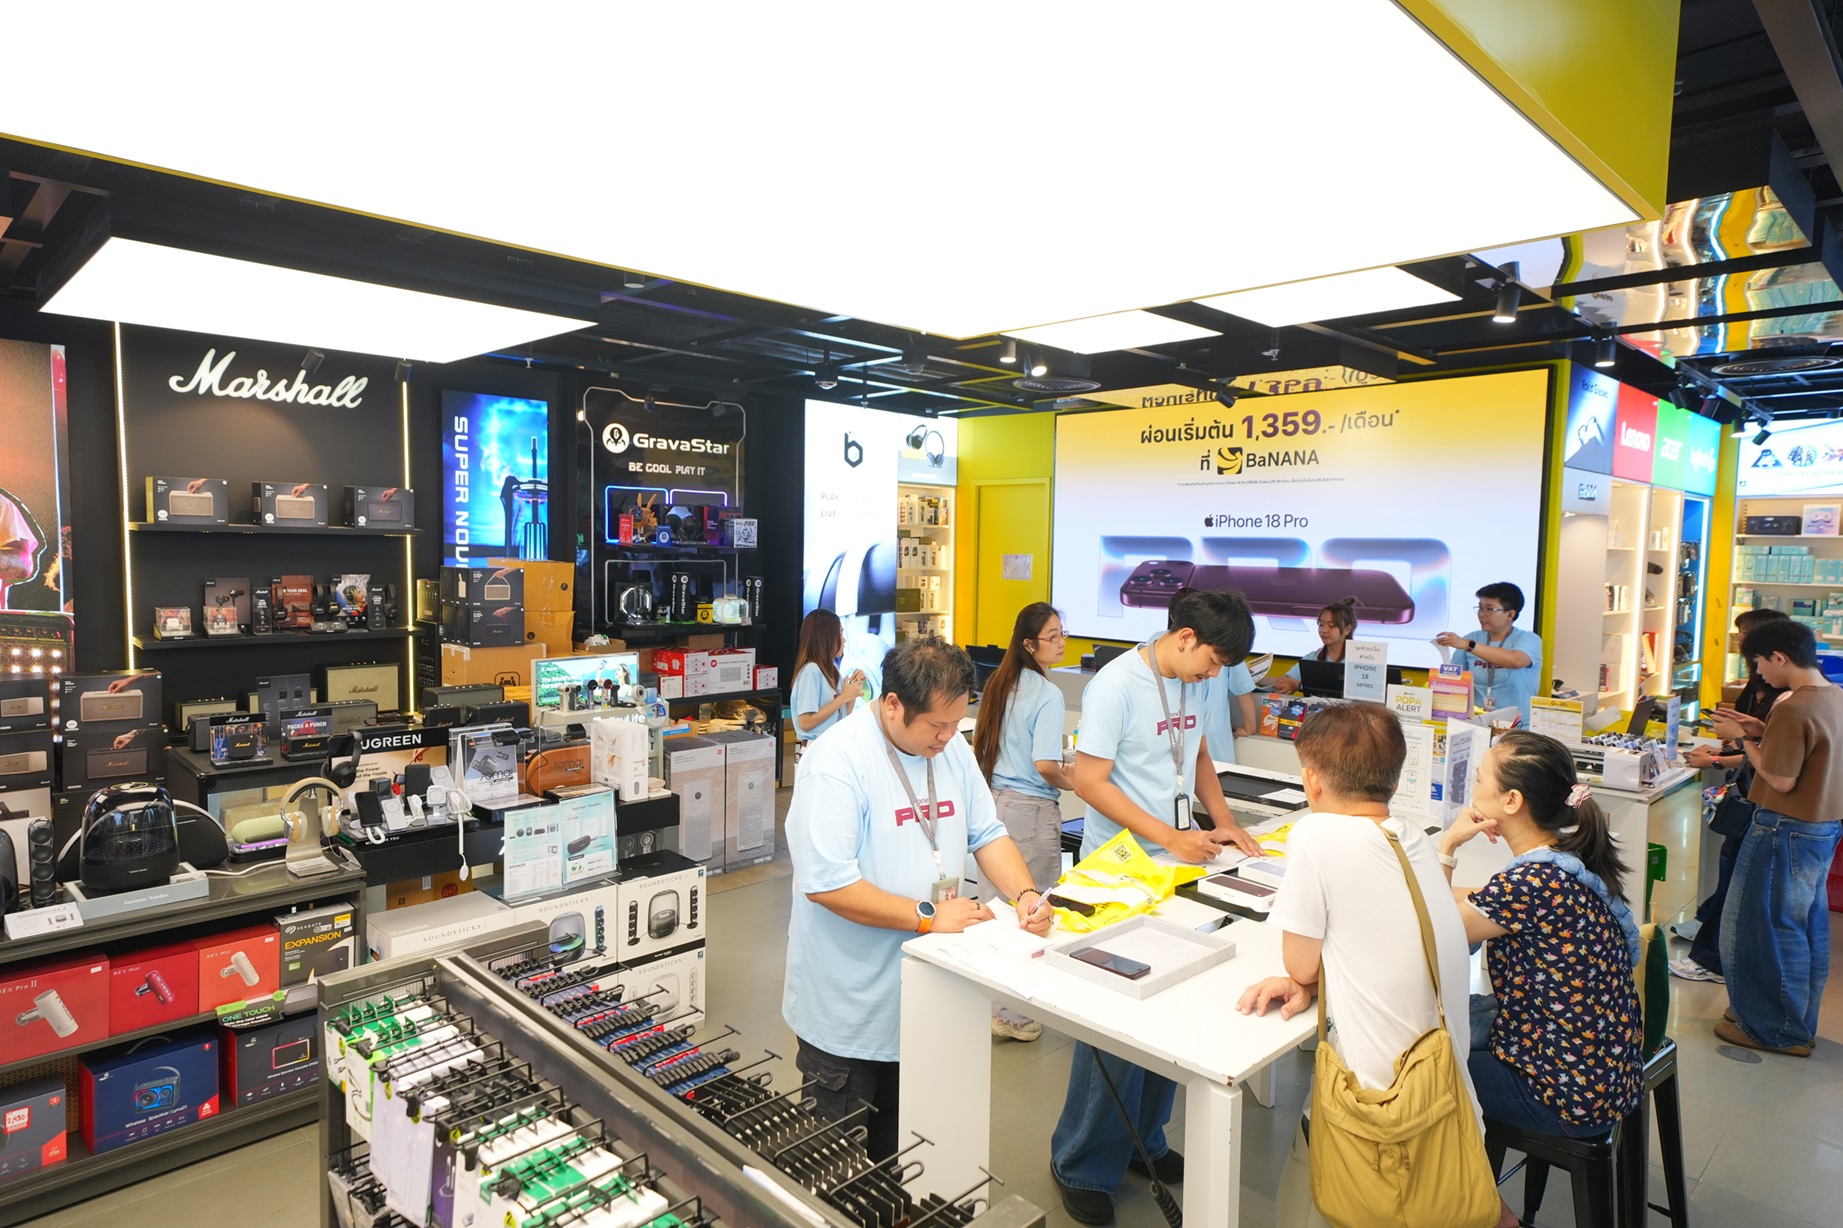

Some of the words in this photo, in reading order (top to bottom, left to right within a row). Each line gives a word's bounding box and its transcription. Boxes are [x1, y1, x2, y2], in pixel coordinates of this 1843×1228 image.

[168, 348, 369, 409] Marshall
[1141, 418, 1234, 444] ผ่อนเริ่มต้น
[1620, 421, 1651, 453] Lenovo
[633, 433, 730, 455] GravaStar
[454, 416, 470, 503] SUPER
[1200, 449, 1211, 471] ที่
[1246, 449, 1320, 468] BaNANA
[628, 462, 643, 472] BE
[675, 466, 696, 476] PLAY
[697, 467, 706, 476] IT
[1215, 514, 1262, 528] iPhone
[1265, 514, 1280, 528] 18
[1284, 514, 1309, 528] Pro
[455, 511, 470, 568] NOV
[348, 685, 379, 694] Marshall
[1396, 695, 1422, 705] PDPA
[1396, 704, 1421, 712] ALERT
[287, 722, 304, 730] PACKS
[360, 734, 422, 750] UGREEN
[639, 876, 682, 889] SOUNDSTICKS
[538, 898, 589, 913] SOUNDSTICKS
[296, 922, 322, 931] SEAGATE
[423, 924, 481, 942] SOUNDSTICKS
[284, 930, 341, 950] EXPANSION
[638, 959, 682, 974] SOUNDSTICKS
[222, 1013, 242, 1022] ONE
[243, 1005, 275, 1017] TOUCH
[125, 1119, 146, 1128] Wireless
[148, 1112, 169, 1121] Speaker
